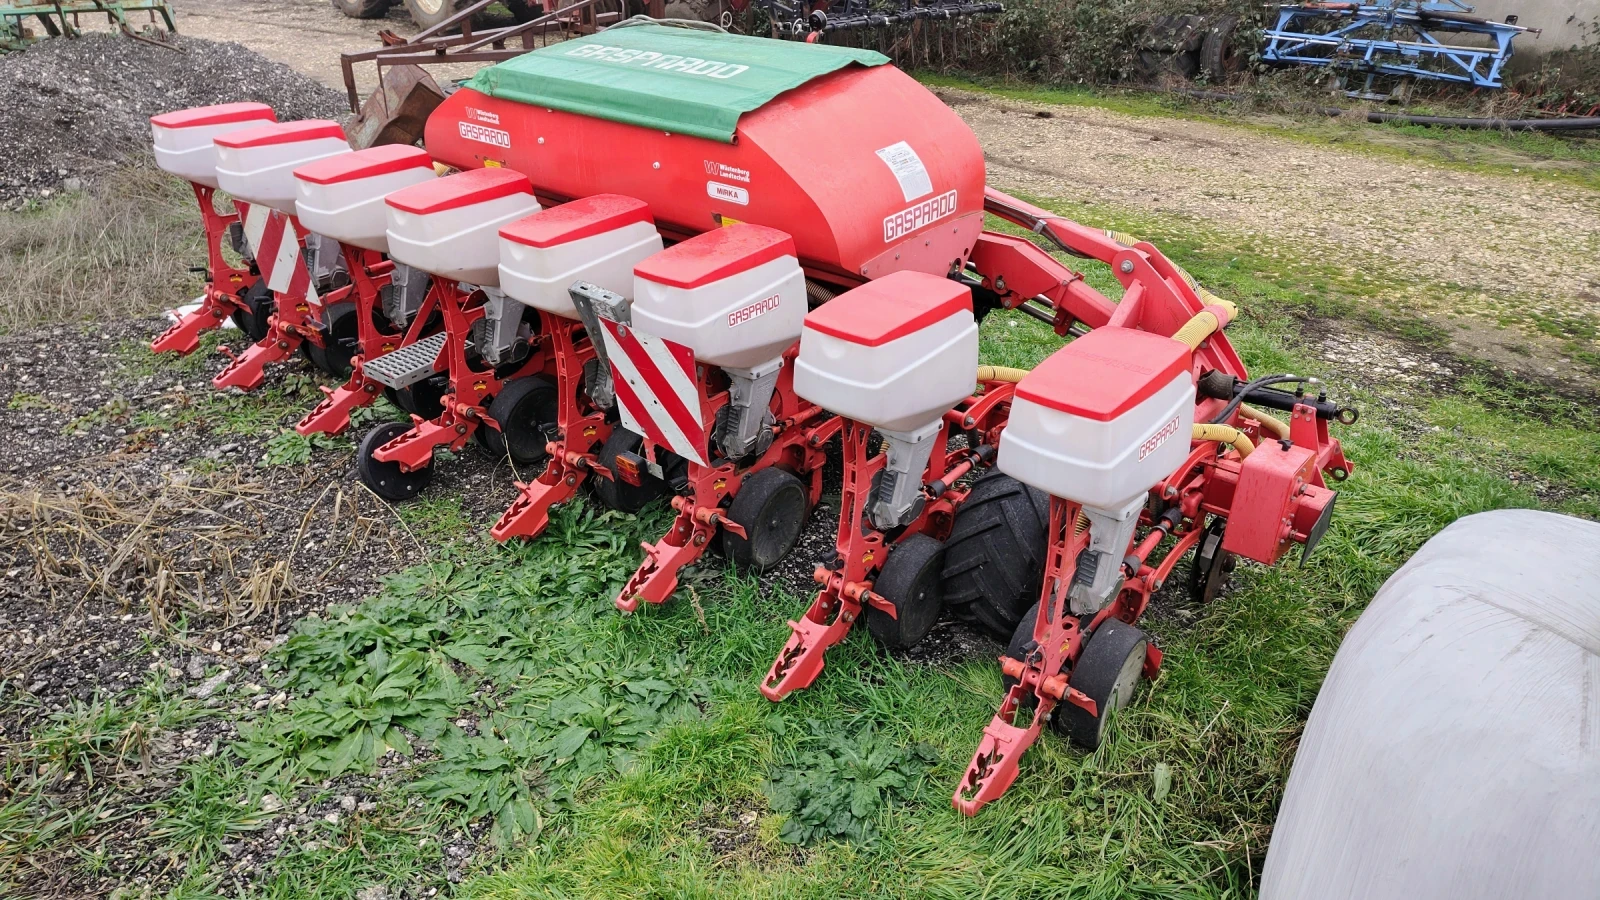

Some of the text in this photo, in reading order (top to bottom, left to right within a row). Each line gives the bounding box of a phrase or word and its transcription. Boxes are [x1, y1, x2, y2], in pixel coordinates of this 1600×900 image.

[564, 44, 750, 79] GASPARDO
[460, 122, 510, 147] GASPARDO
[716, 187, 739, 199] MIRKA
[884, 191, 956, 241] GASPARDO
[728, 294, 780, 327] GASPARDO
[1139, 415, 1180, 461] GASPARDO
